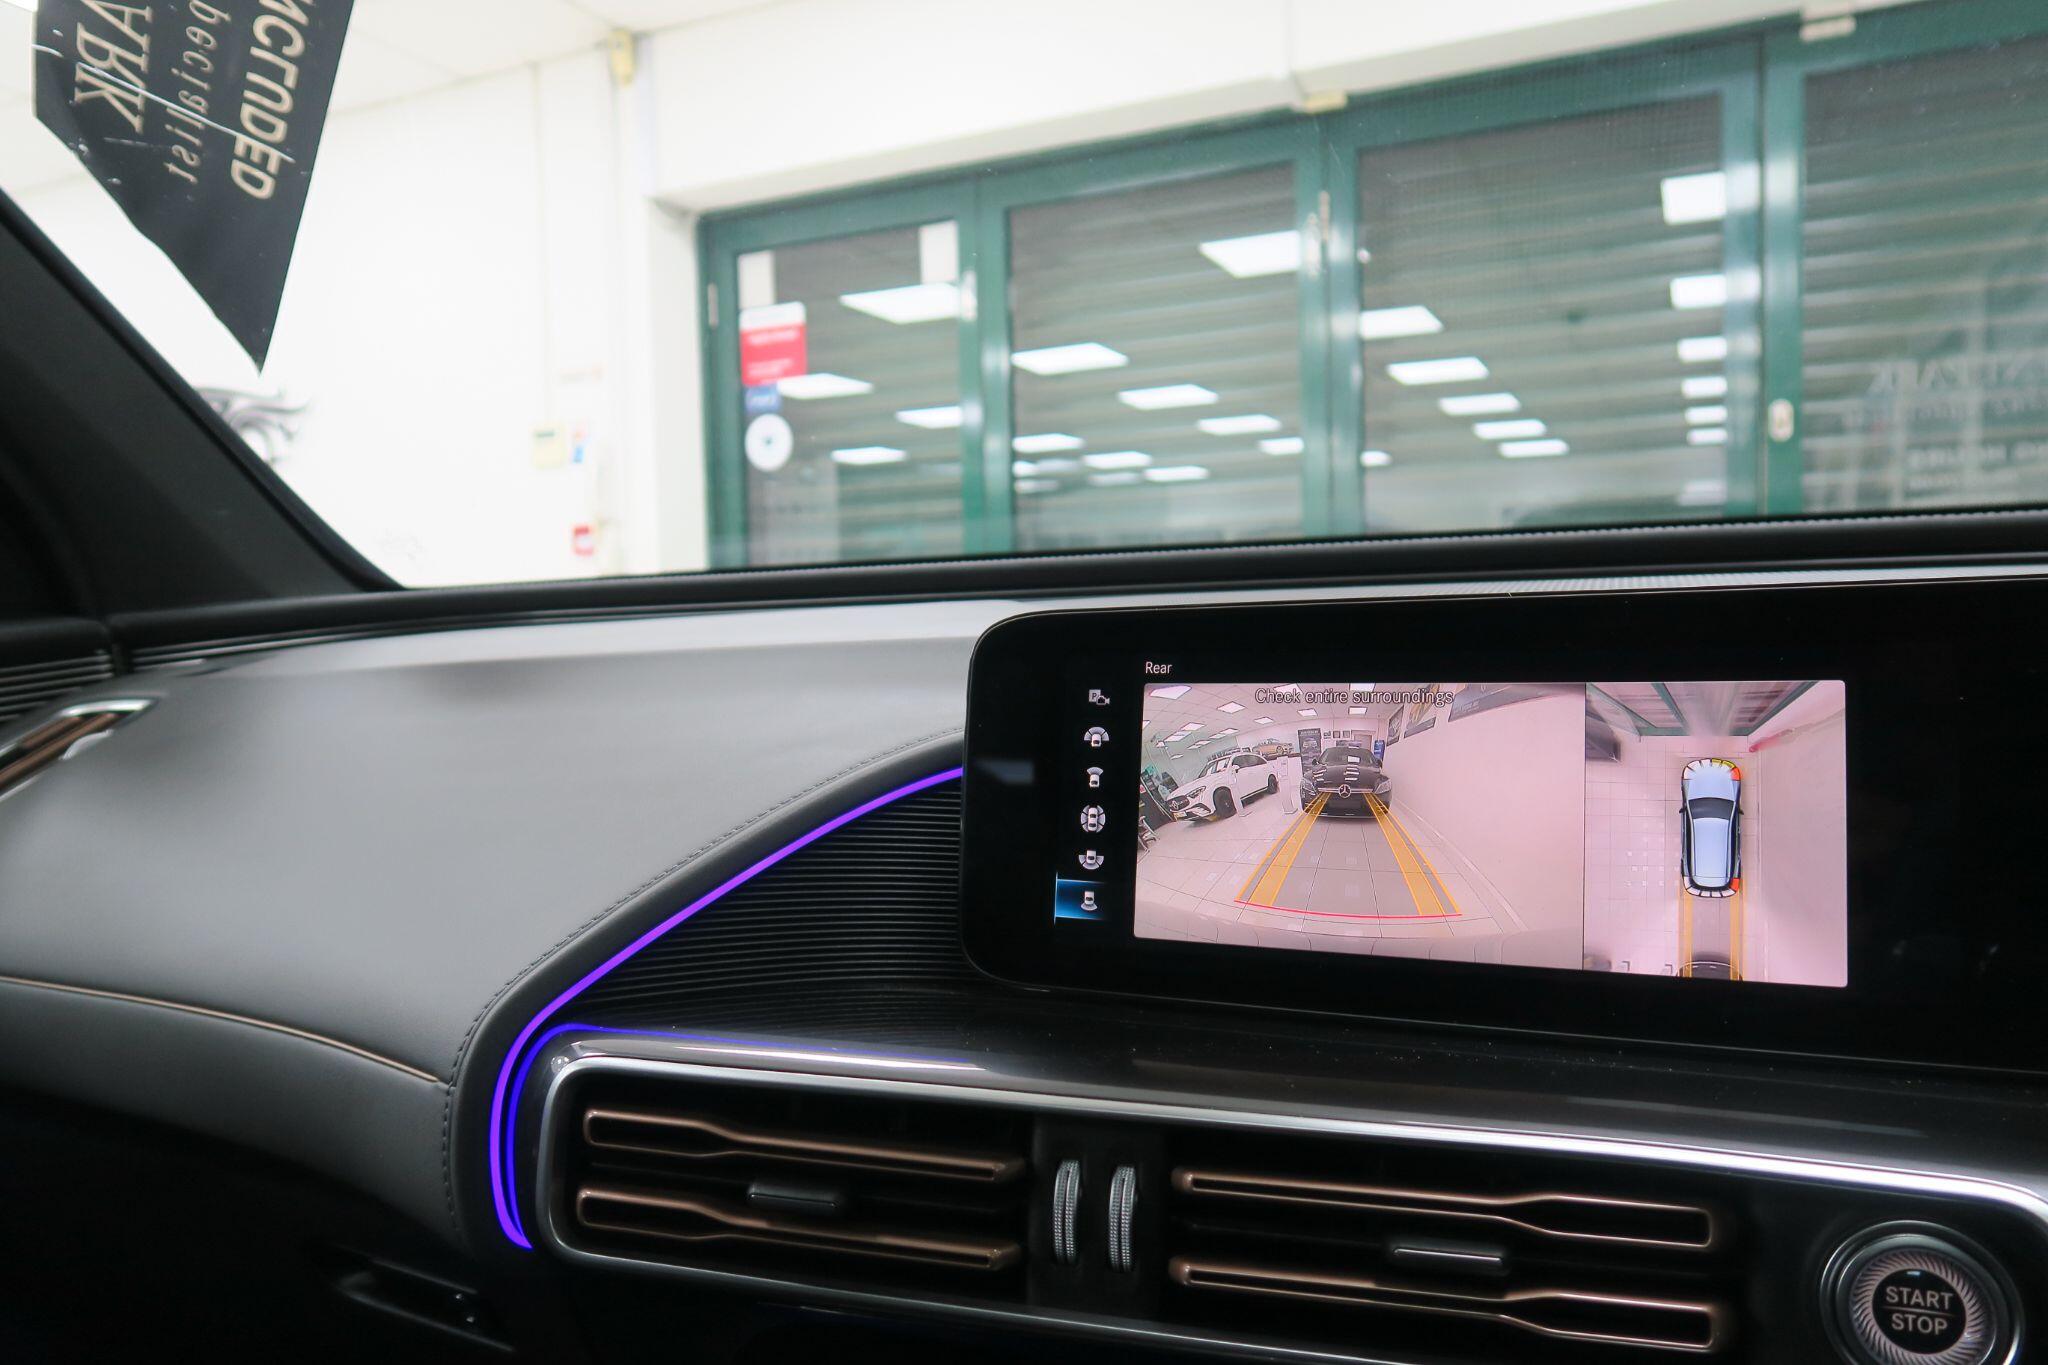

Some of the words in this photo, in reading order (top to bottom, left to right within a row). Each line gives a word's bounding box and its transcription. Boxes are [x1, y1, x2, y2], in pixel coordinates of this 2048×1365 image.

[1145, 661, 1173, 675] Rear
[1254, 687, 1301, 704] Check
[1304, 688, 1348, 704] entire
[1352, 687, 1455, 708] surroundings
[1885, 1286, 1954, 1310] START
[1891, 1313, 1948, 1335] STOP
